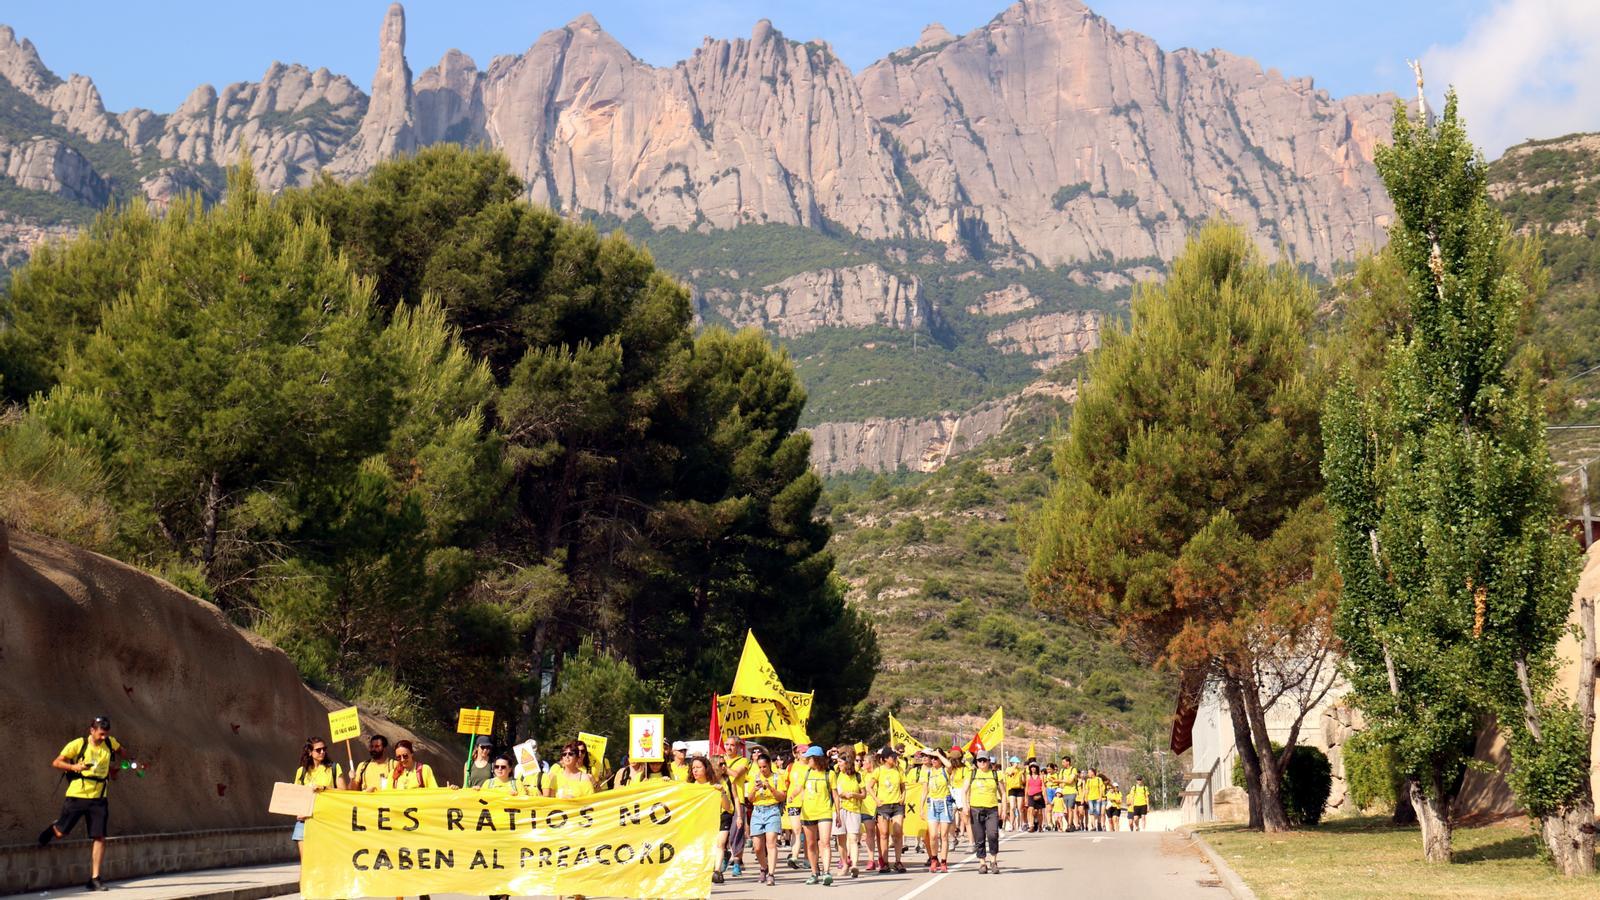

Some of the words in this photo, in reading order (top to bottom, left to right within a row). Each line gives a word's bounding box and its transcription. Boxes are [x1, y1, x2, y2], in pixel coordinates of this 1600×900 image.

[725, 710, 749, 721] VIDA
[727, 723, 761, 736] DIGNA
[352, 806, 419, 832] LES
[447, 799, 595, 832] RÀTIOS
[620, 801, 672, 827] NO
[352, 847, 454, 871] CABEN
[470, 849, 505, 870] AL
[520, 842, 676, 869] PREACORD
